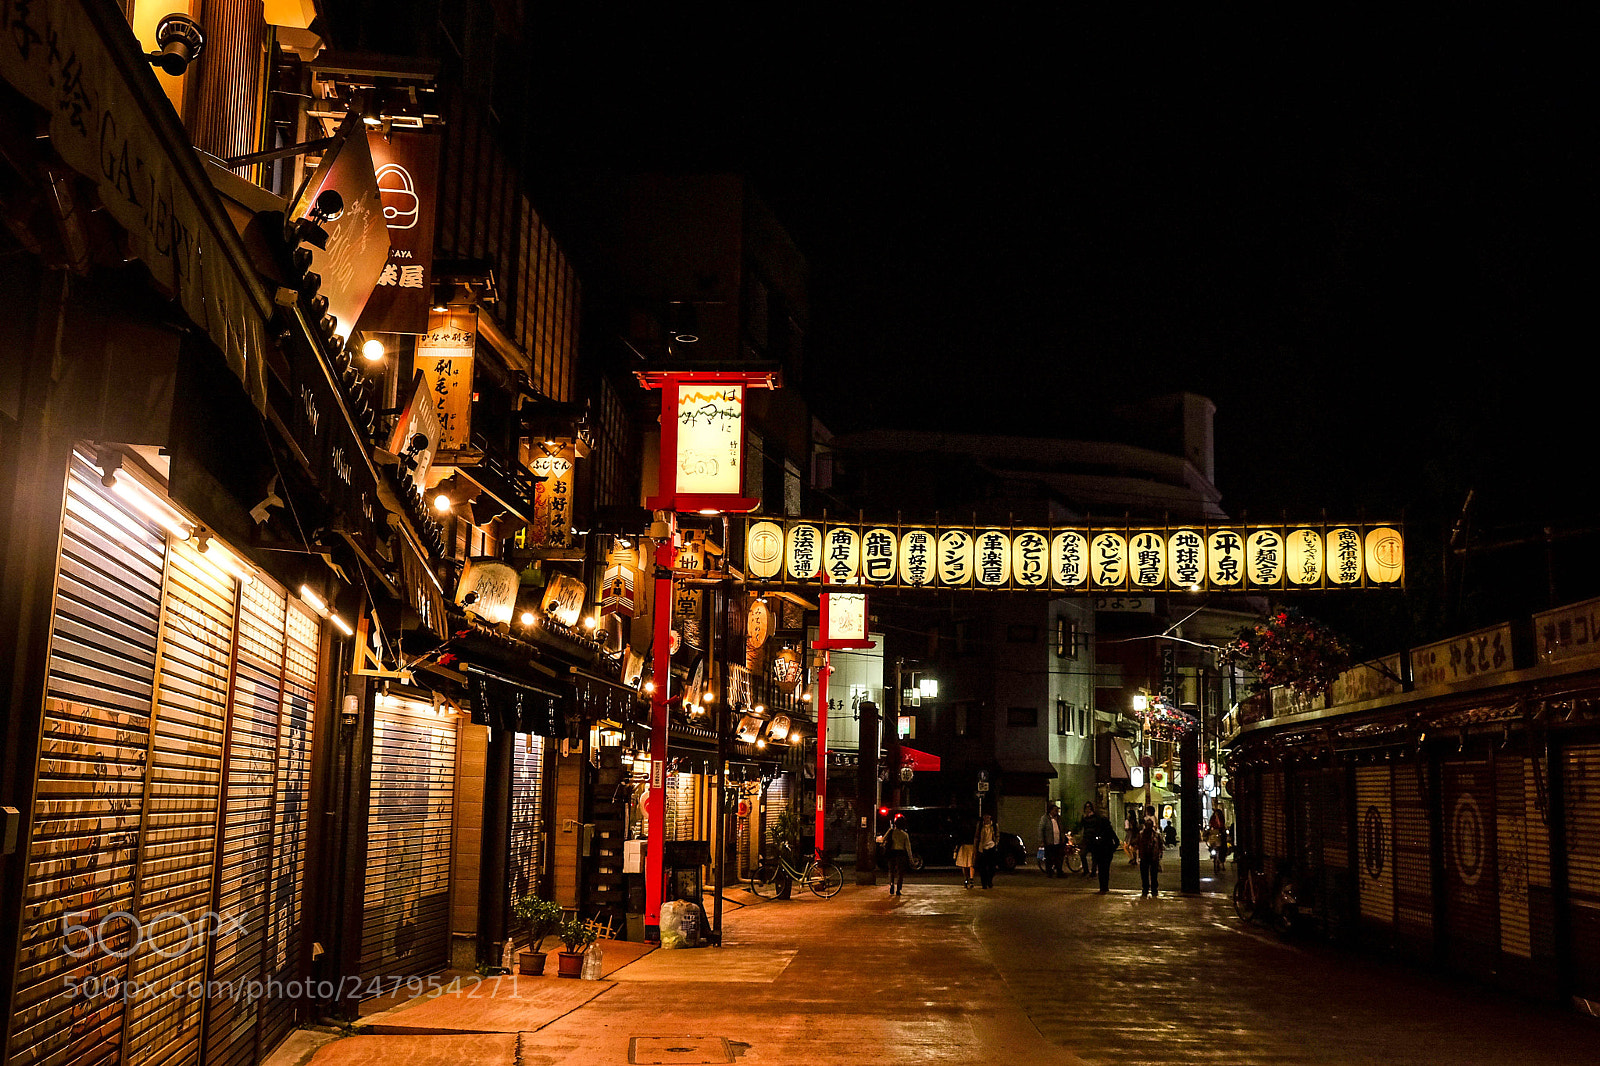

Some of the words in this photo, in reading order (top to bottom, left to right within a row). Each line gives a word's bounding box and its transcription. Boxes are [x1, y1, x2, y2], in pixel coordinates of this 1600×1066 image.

[830, 530, 852, 578] 商店会
[981, 534, 1003, 583] 革楽屋
[1020, 534, 1047, 584] みどりや
[1061, 534, 1081, 584] かなや刷子
[1097, 534, 1122, 585] ふじでん
[1137, 534, 1161, 585] 小野屋
[1176, 534, 1200, 583] 地球堂
[1214, 534, 1241, 582] 平泉
[1255, 532, 1279, 583] ら麺亭
